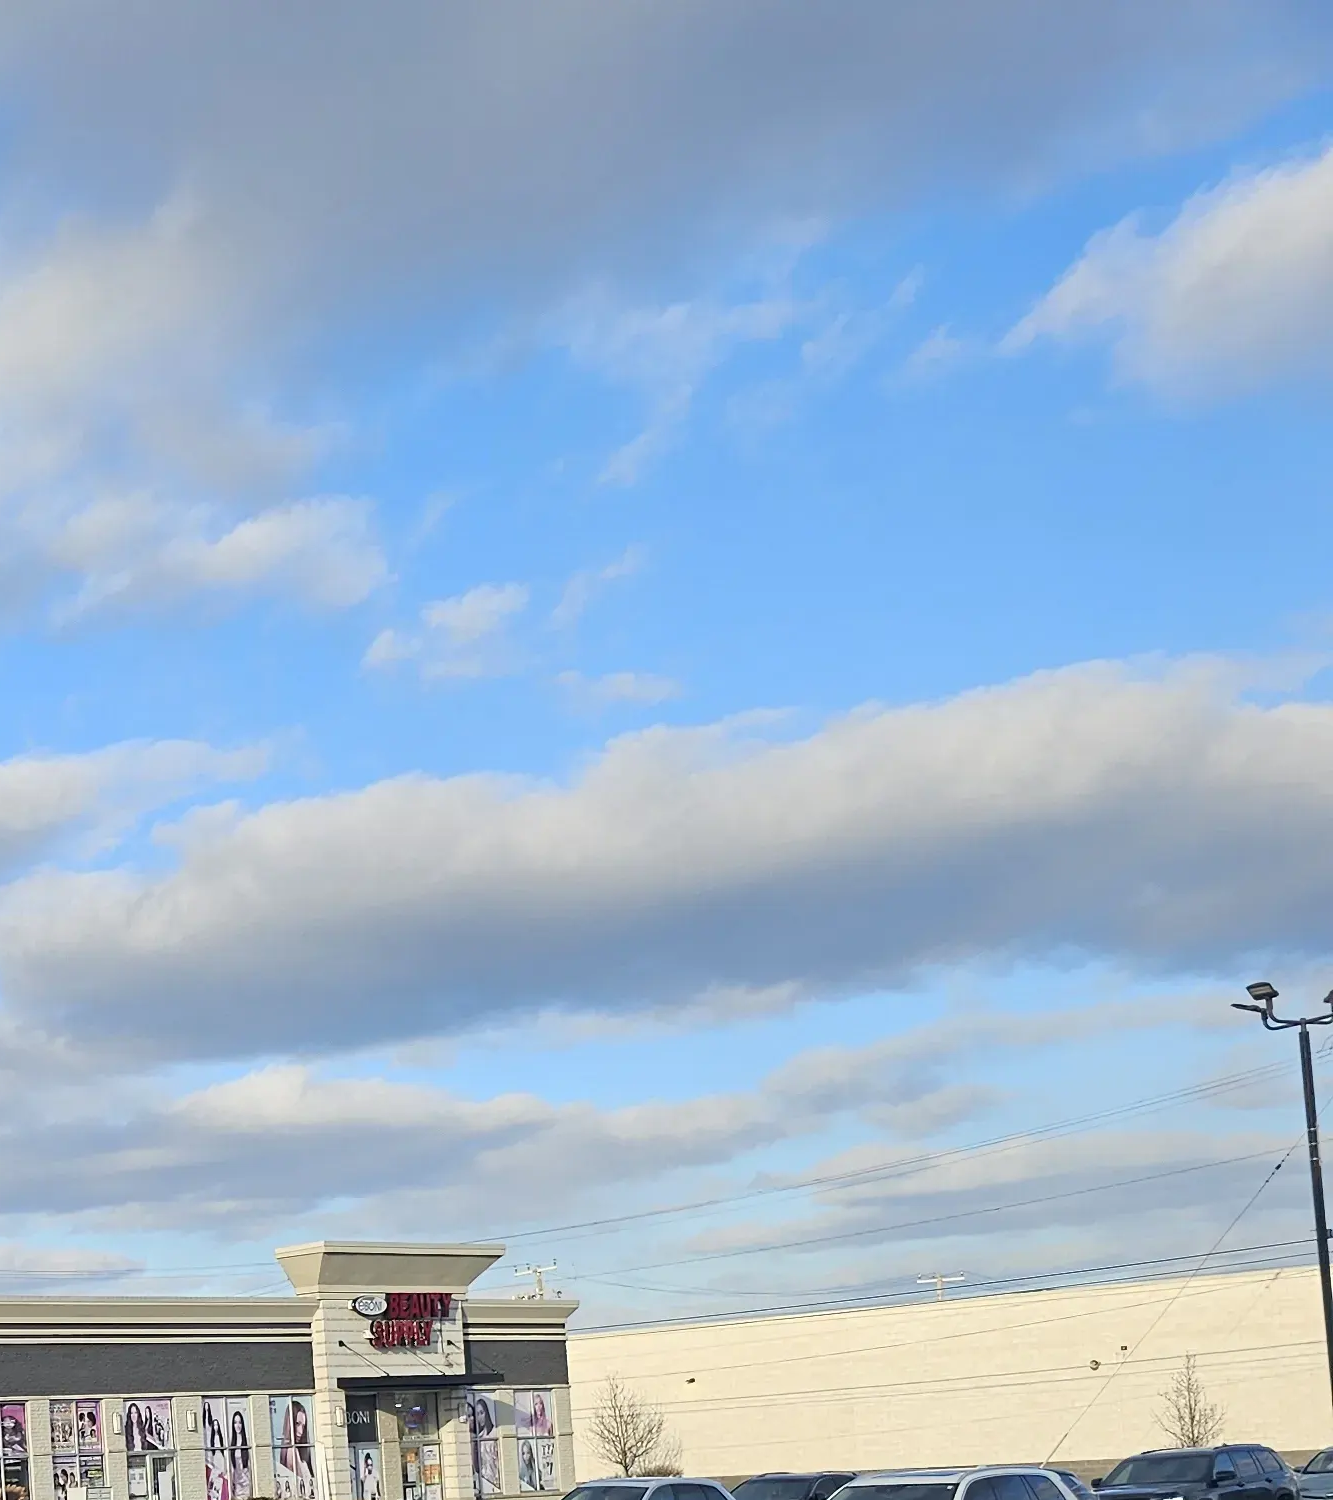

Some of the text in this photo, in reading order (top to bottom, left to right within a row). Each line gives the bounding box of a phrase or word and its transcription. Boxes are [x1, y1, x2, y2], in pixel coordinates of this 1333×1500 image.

[388, 1293, 452, 1318] BEAUTY
[372, 1319, 433, 1348] SUPPLY
[346, 1410, 370, 1425] BONI
